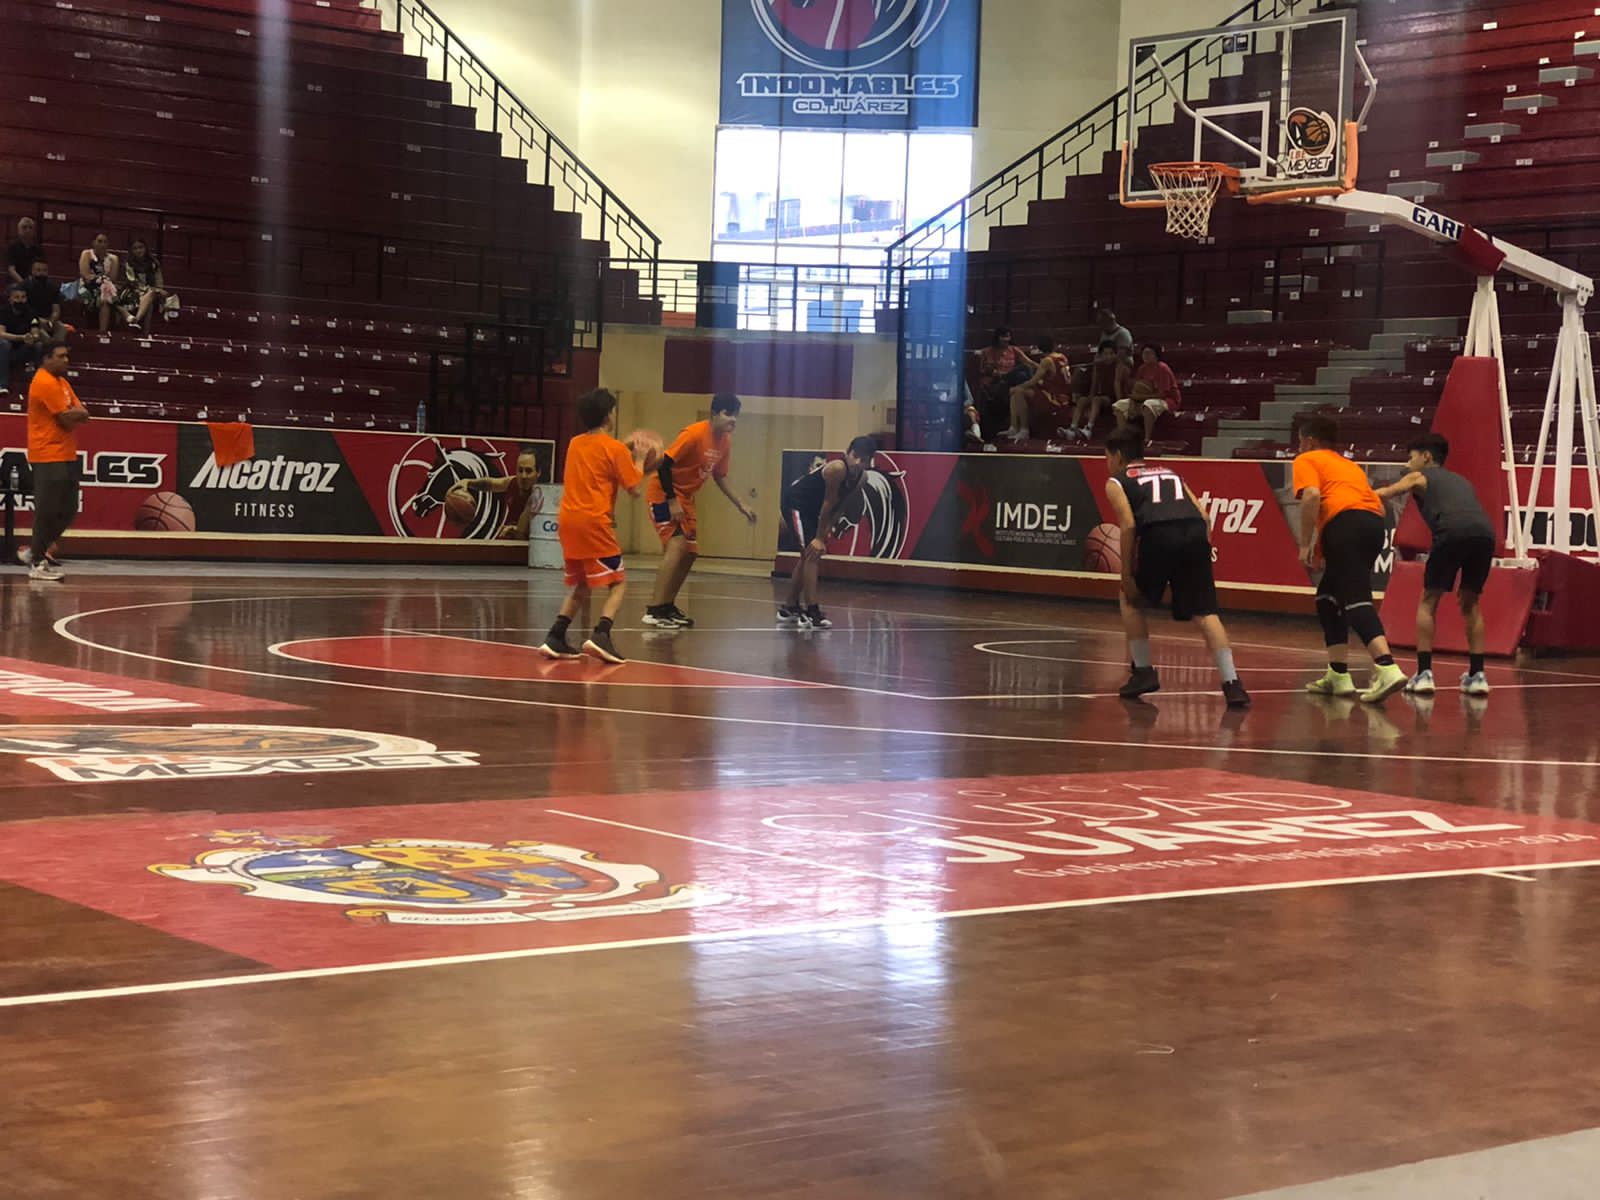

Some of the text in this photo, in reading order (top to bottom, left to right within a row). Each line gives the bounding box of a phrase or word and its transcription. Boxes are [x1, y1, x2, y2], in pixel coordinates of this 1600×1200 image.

[737, 73, 963, 97] INDOMABLES
[794, 97, 907, 113] CD. JUÁREZ
[189, 451, 340, 493] Alcatraz
[1137, 474, 1185, 504] 77
[235, 502, 296, 518] FITNESS
[995, 501, 1072, 533] IMDEJ
[68, 751, 466, 780] MEXBET
[760, 791, 1352, 836] CIUDAD
[917, 810, 1526, 863] JUÁREZ
[1013, 858, 1218, 878] Gobierno
